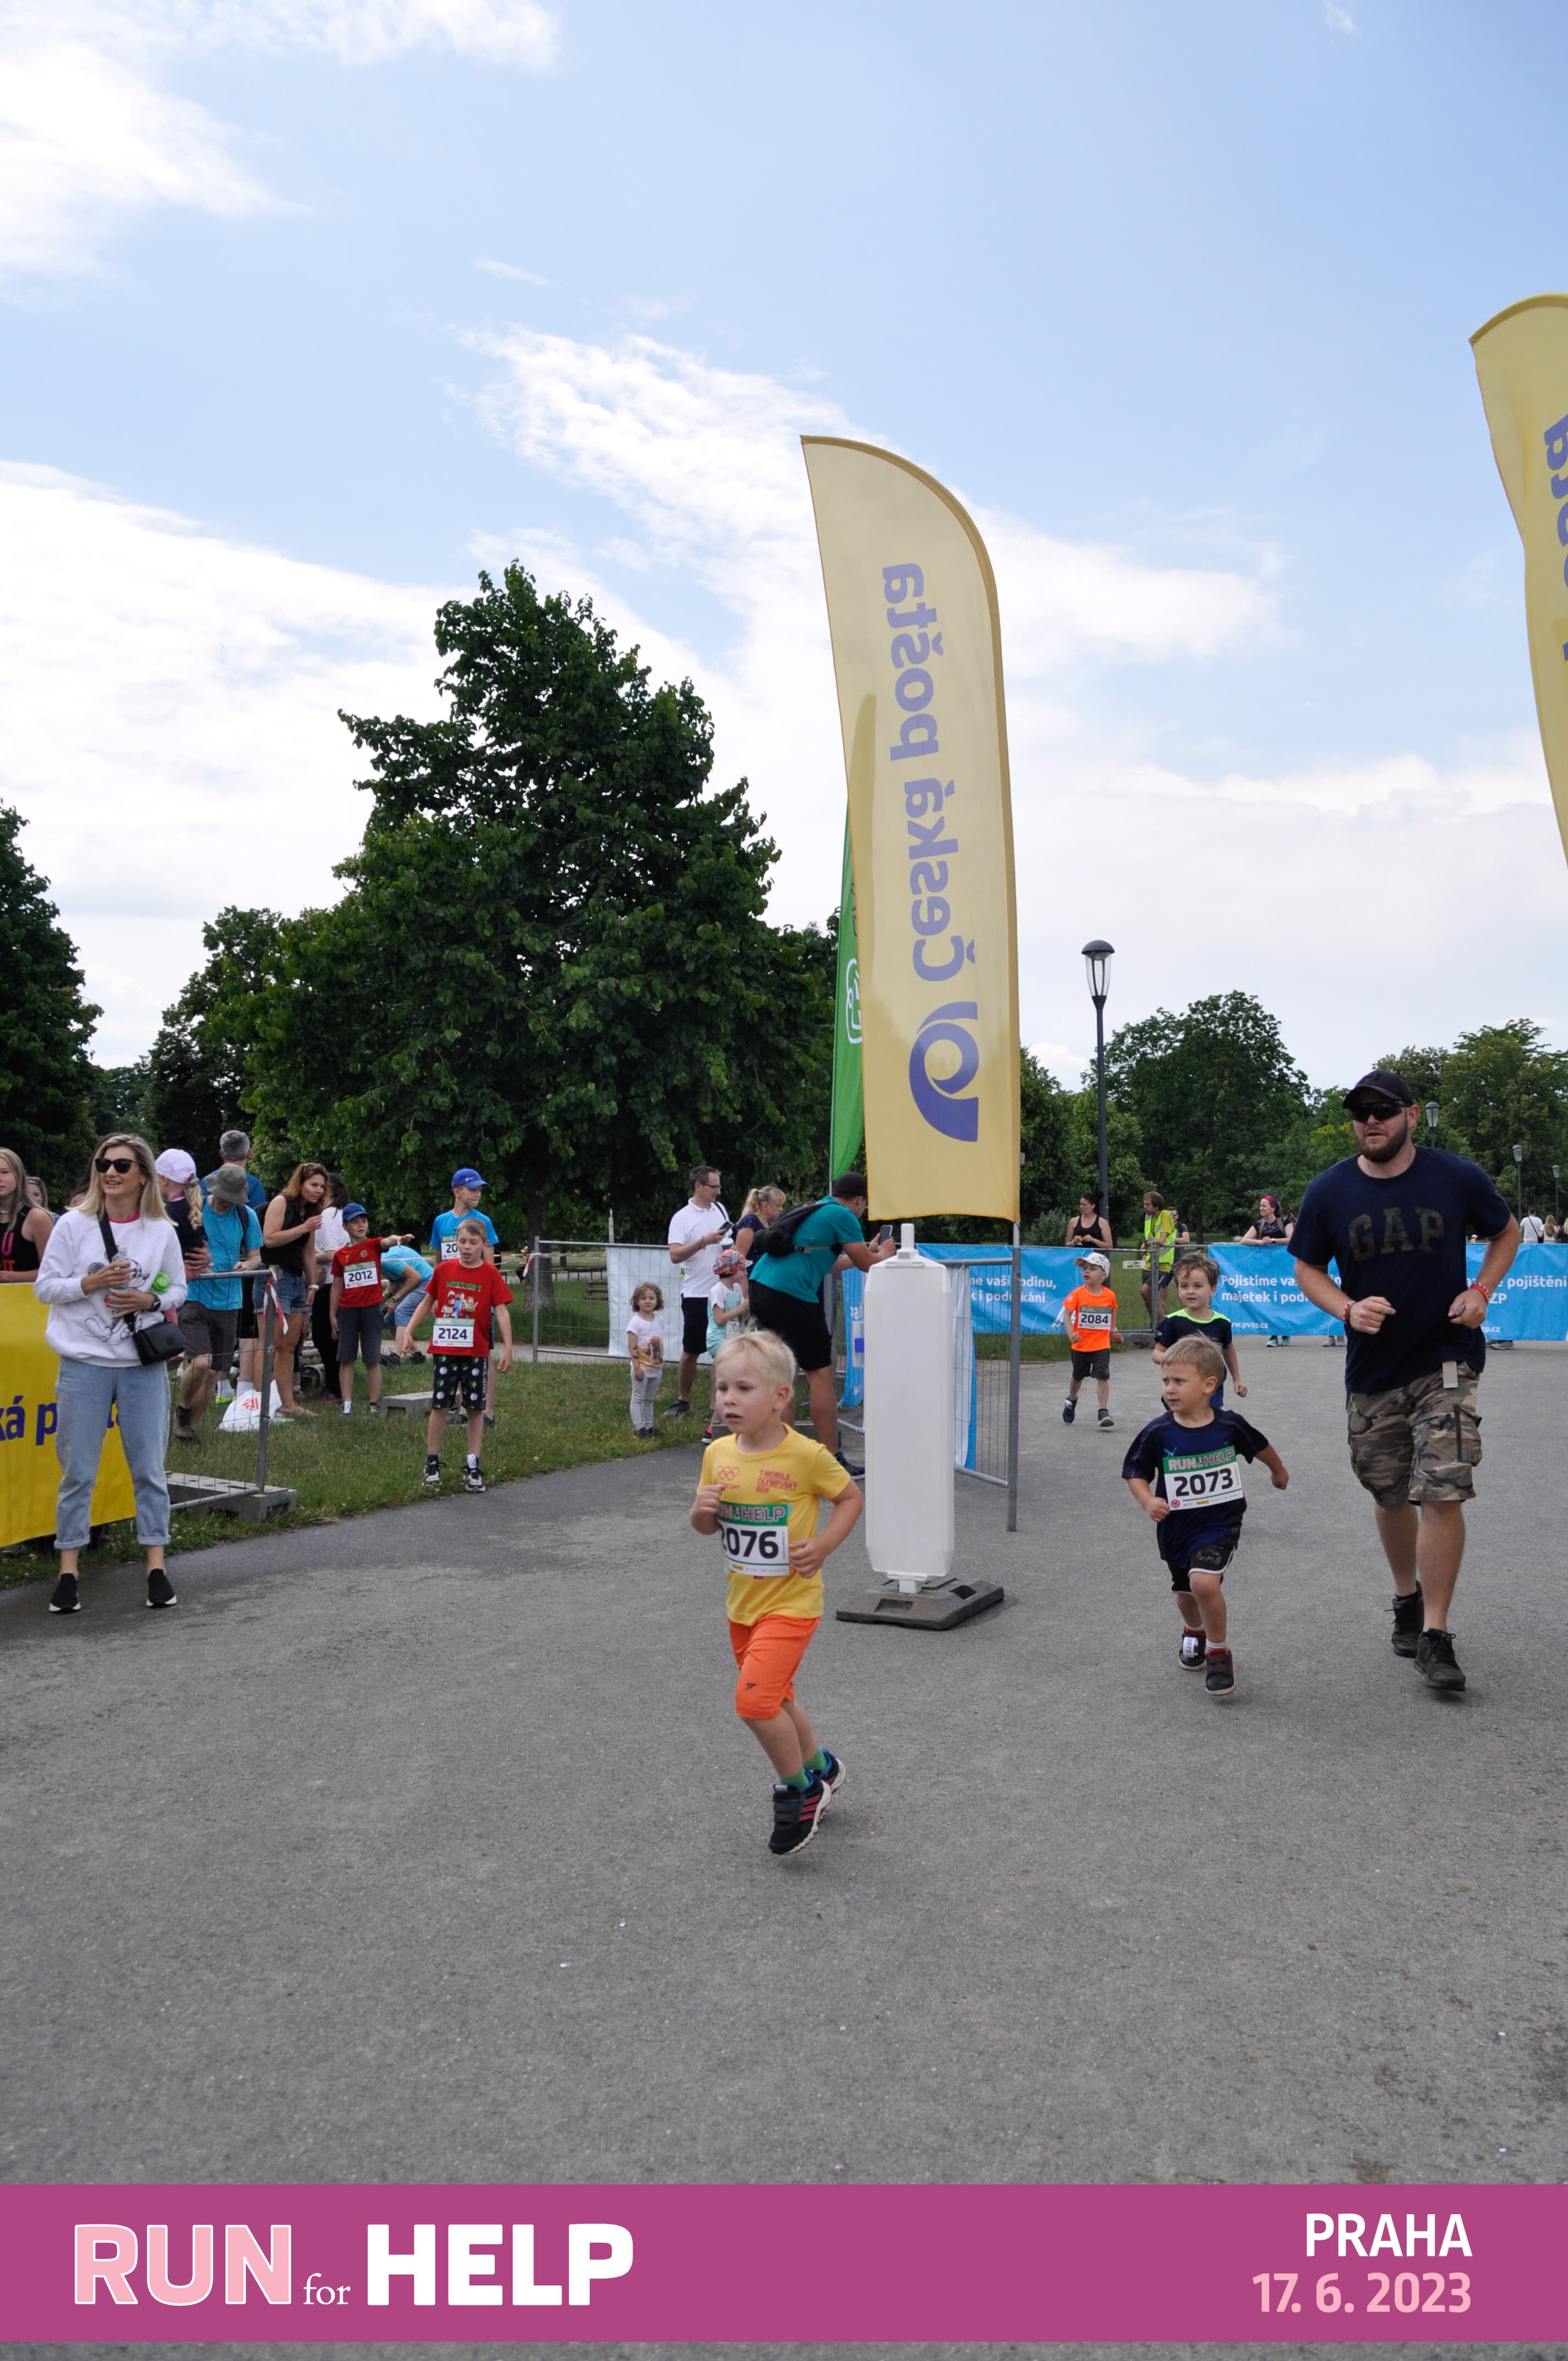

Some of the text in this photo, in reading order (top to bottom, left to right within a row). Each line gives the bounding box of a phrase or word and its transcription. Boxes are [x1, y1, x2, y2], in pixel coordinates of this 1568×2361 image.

[1348, 1206, 1445, 1262] GAP
[446, 1243, 458, 1253] 20
[349, 1270, 373, 1282] 2012
[986, 1275, 1010, 1287] vaši
[1020, 1276, 1057, 1290] odinu,
[1221, 1274, 1298, 1288] Pojistíme va
[1507, 1275, 1567, 1290] pojištění
[986, 1291, 1046, 1303] podkání
[1222, 1291, 1270, 1303] majetek
[1274, 1291, 1277, 1302] i
[1489, 1293, 1507, 1304] ZP
[1081, 1314, 1108, 1324] 2084
[438, 1328, 467, 1340] 2124
[1168, 1458, 1196, 1471] RUN
[1204, 1449, 1234, 1466] HELP
[1174, 1468, 1233, 1497] 2073
[742, 1506, 785, 1522] HELP
